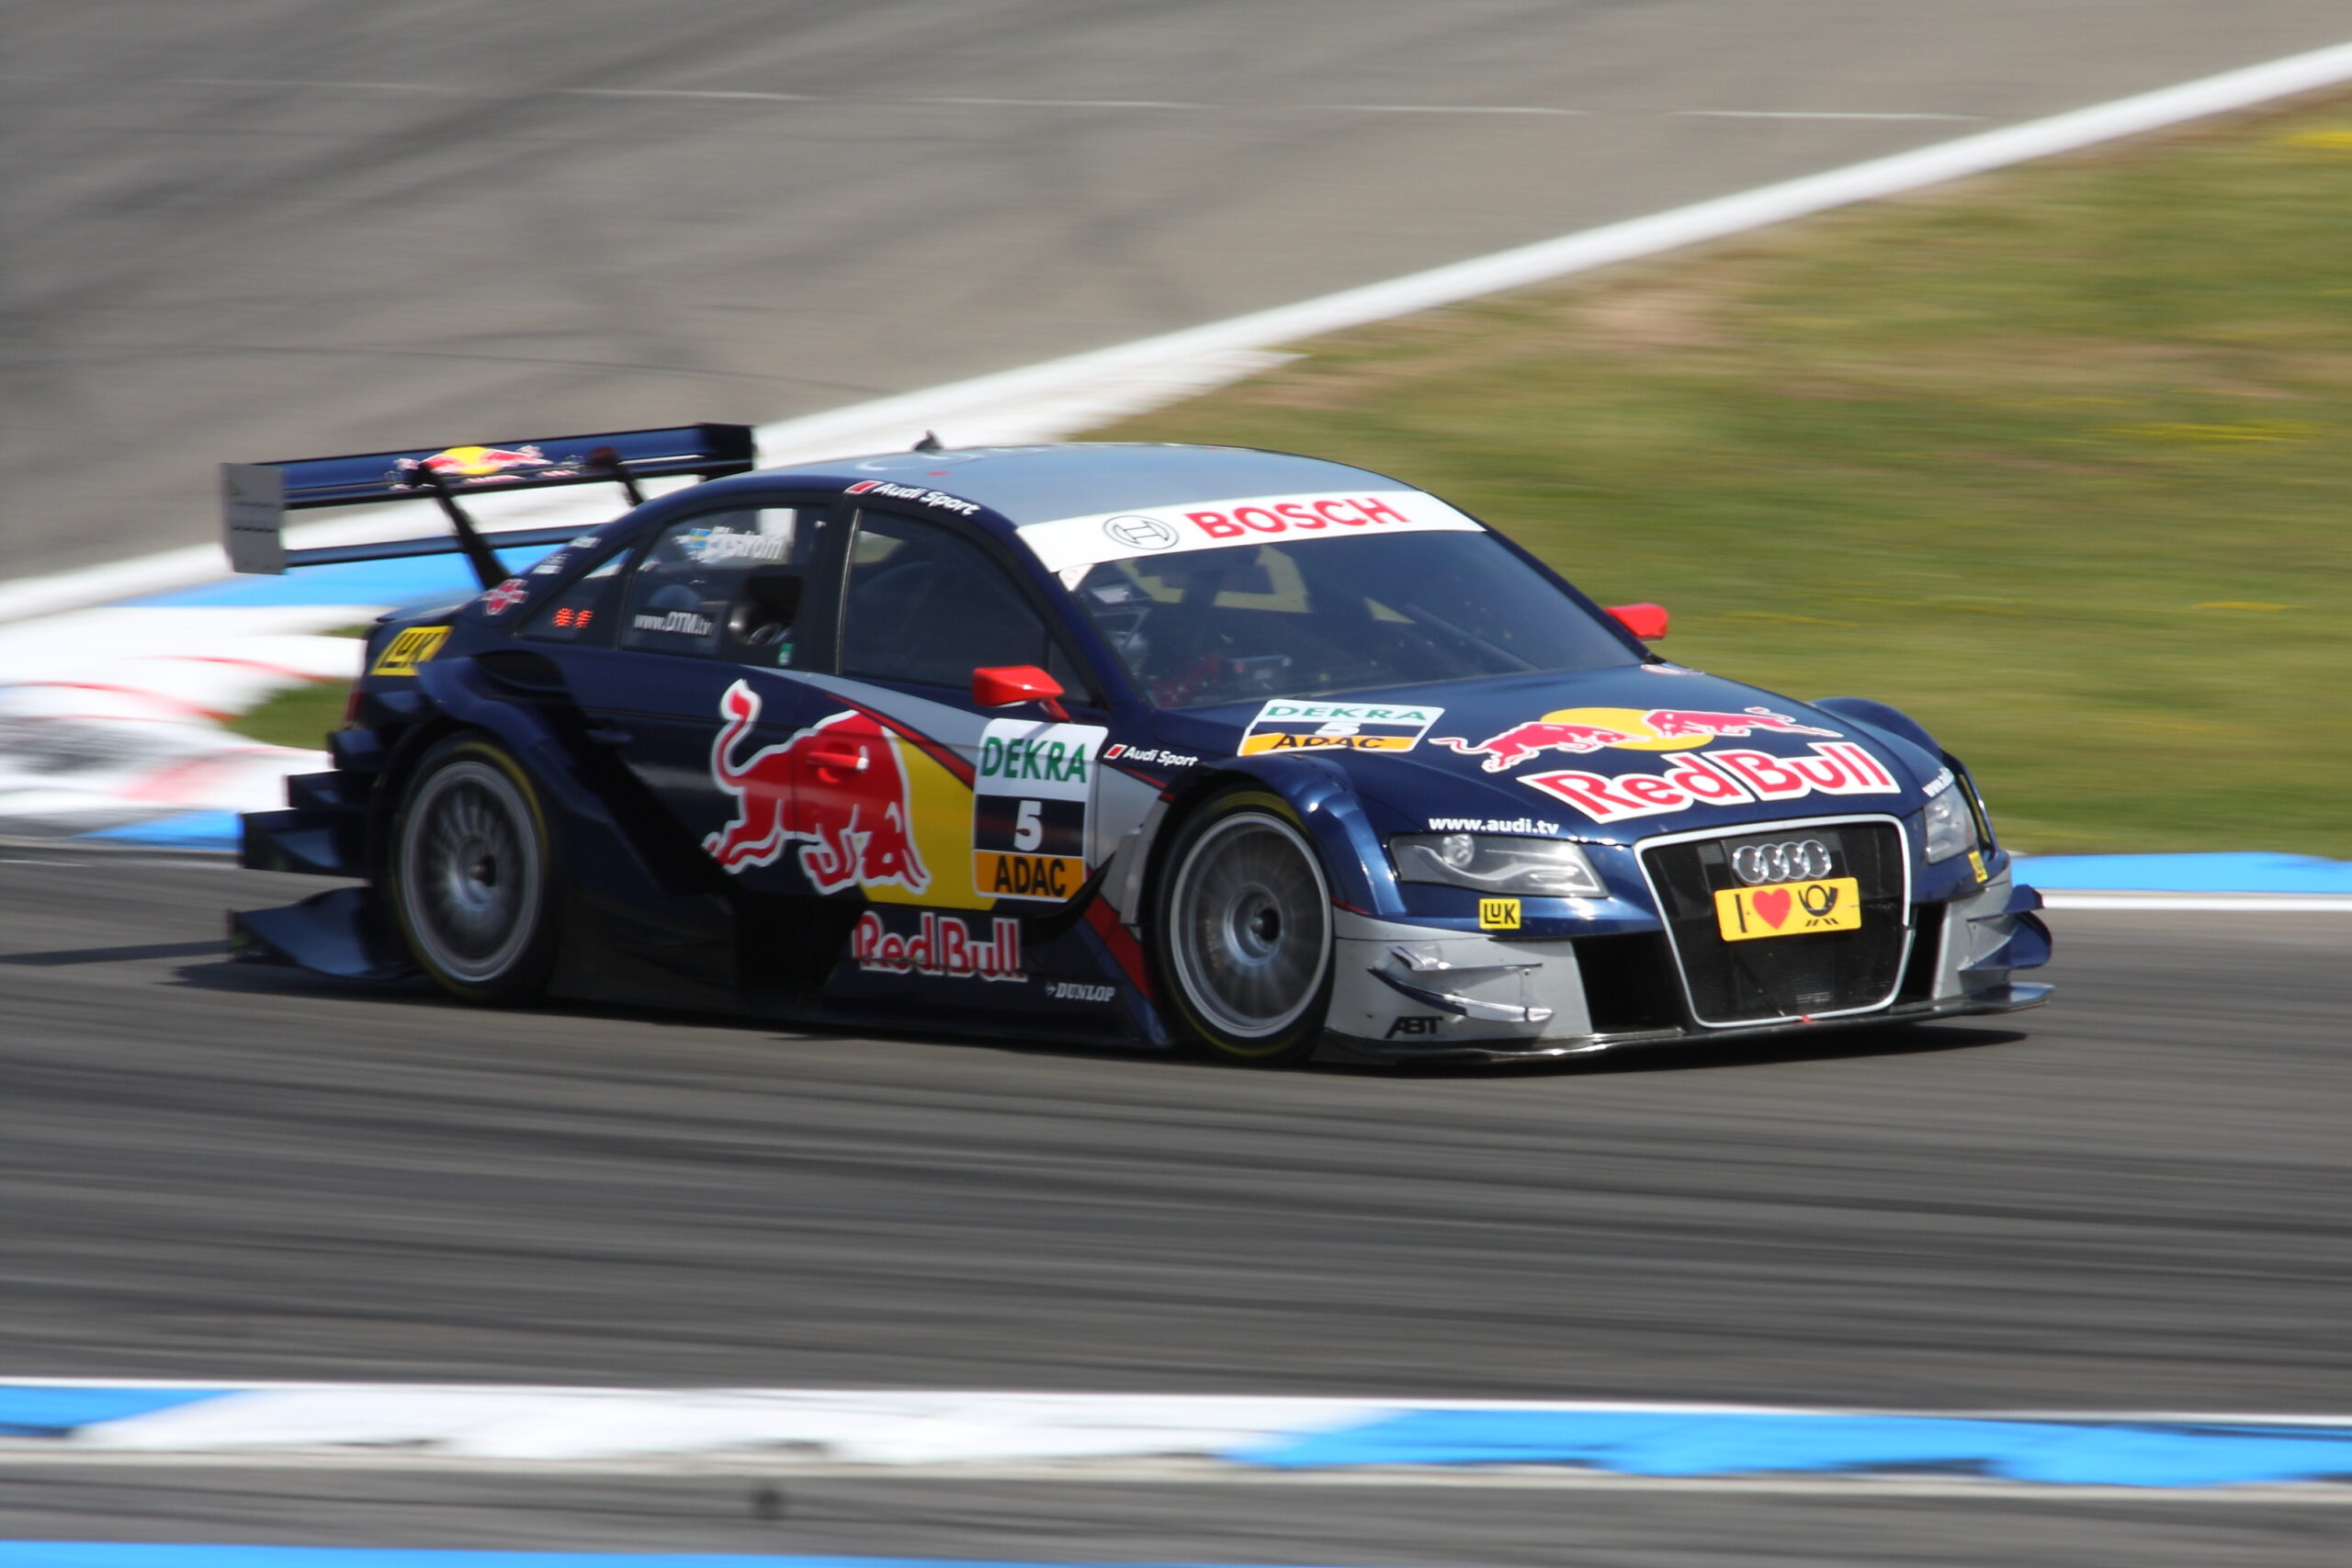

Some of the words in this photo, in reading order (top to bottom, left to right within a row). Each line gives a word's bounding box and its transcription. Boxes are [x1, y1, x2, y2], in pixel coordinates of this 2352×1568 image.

[873, 483, 927, 500] Audi
[919, 491, 981, 516] Sport
[1184, 497, 1412, 539] BOSCH
[1265, 705, 1427, 721] DEKRA
[1314, 721, 1363, 736] 5
[1270, 737, 1385, 750] ADAC
[979, 736, 1088, 784] DEKRA
[1123, 746, 1159, 762] Audi
[1157, 750, 1199, 767] Sport
[1013, 800, 1044, 852] 5
[1429, 818, 1560, 835] www.audi.tv
[993, 854, 1067, 897] ADAC
[1054, 982, 1116, 1002] DUNLOP
[1384, 1016, 1443, 1039] ABT
